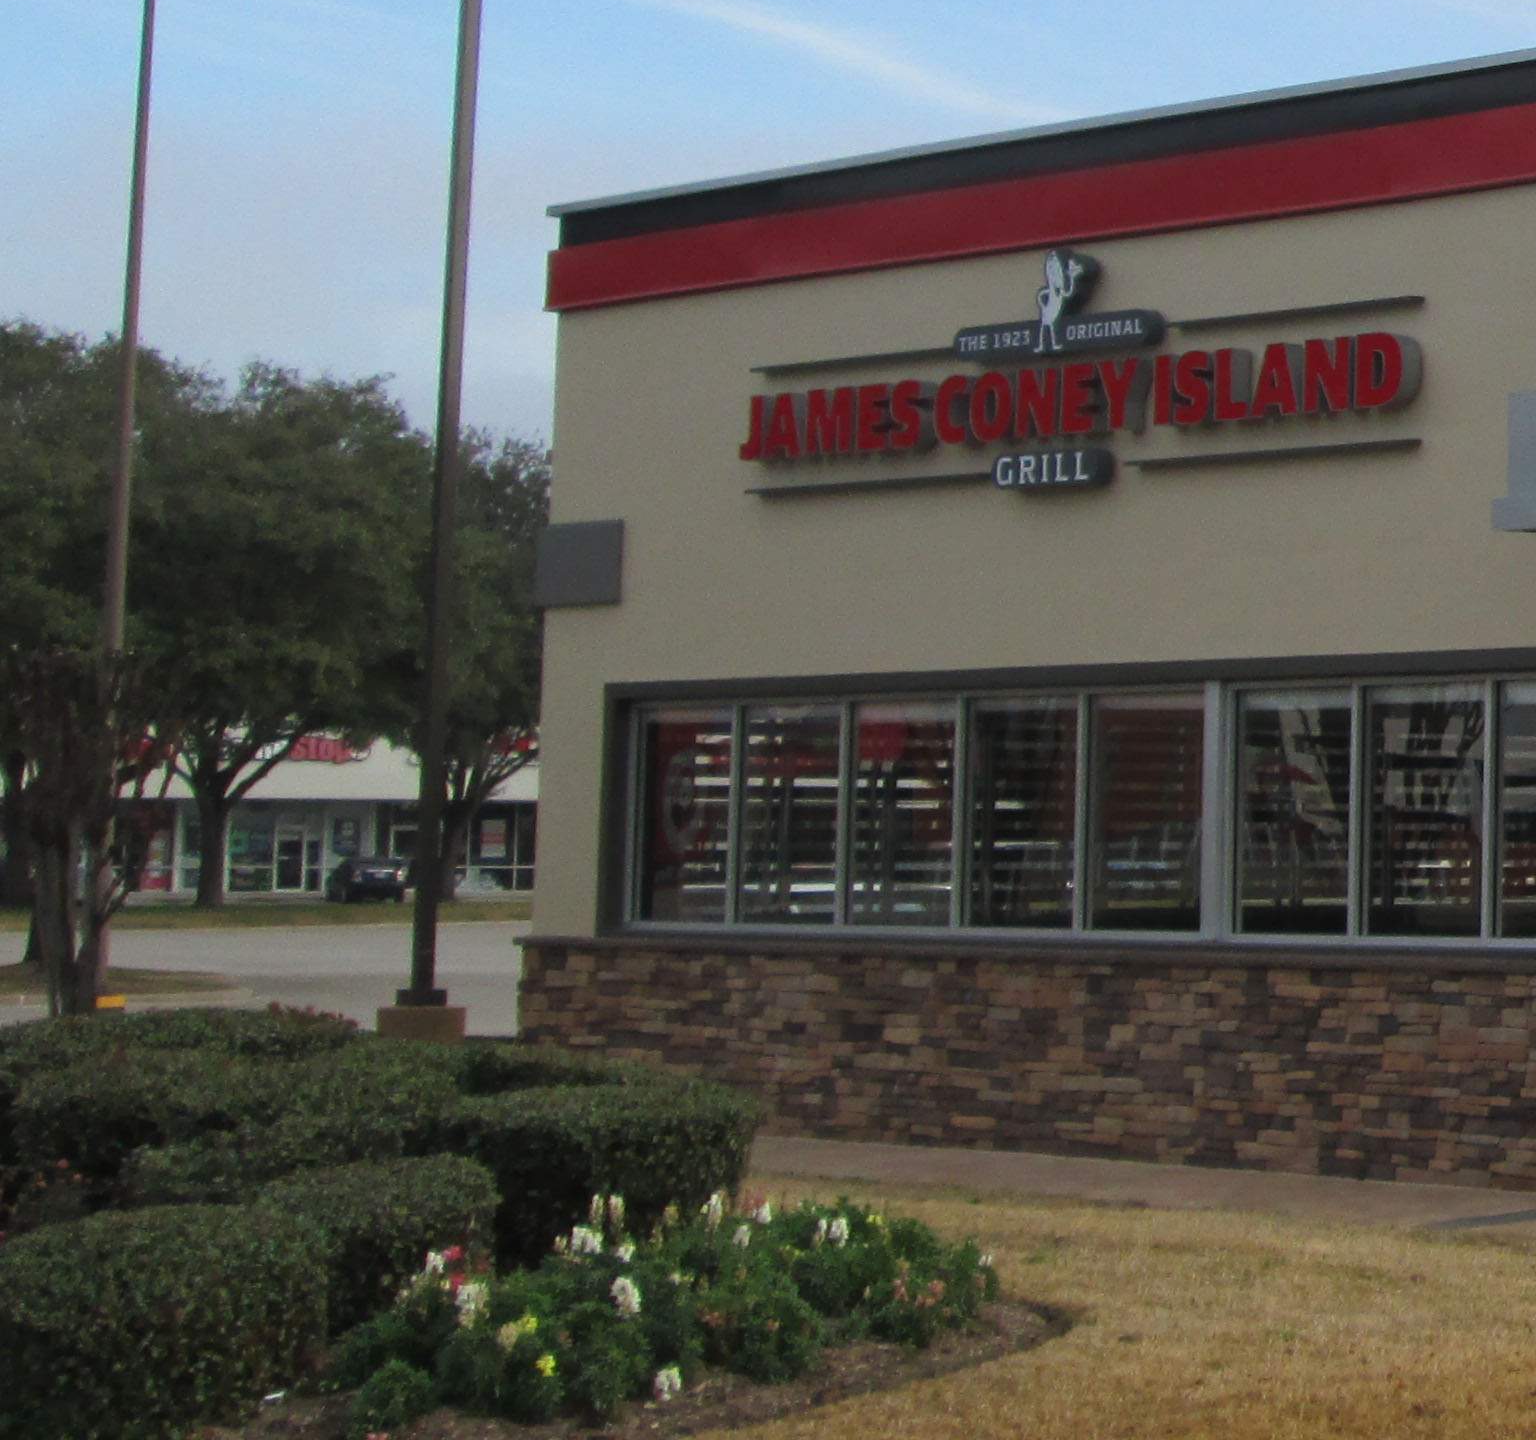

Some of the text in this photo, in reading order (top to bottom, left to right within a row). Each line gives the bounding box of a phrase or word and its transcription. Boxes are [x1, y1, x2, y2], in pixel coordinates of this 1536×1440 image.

[958, 319, 1143, 352] THE 1923 ORIGINAL
[739, 331, 1401, 460] JAMES CONEY ISLAND
[996, 451, 1090, 488] GRILL
